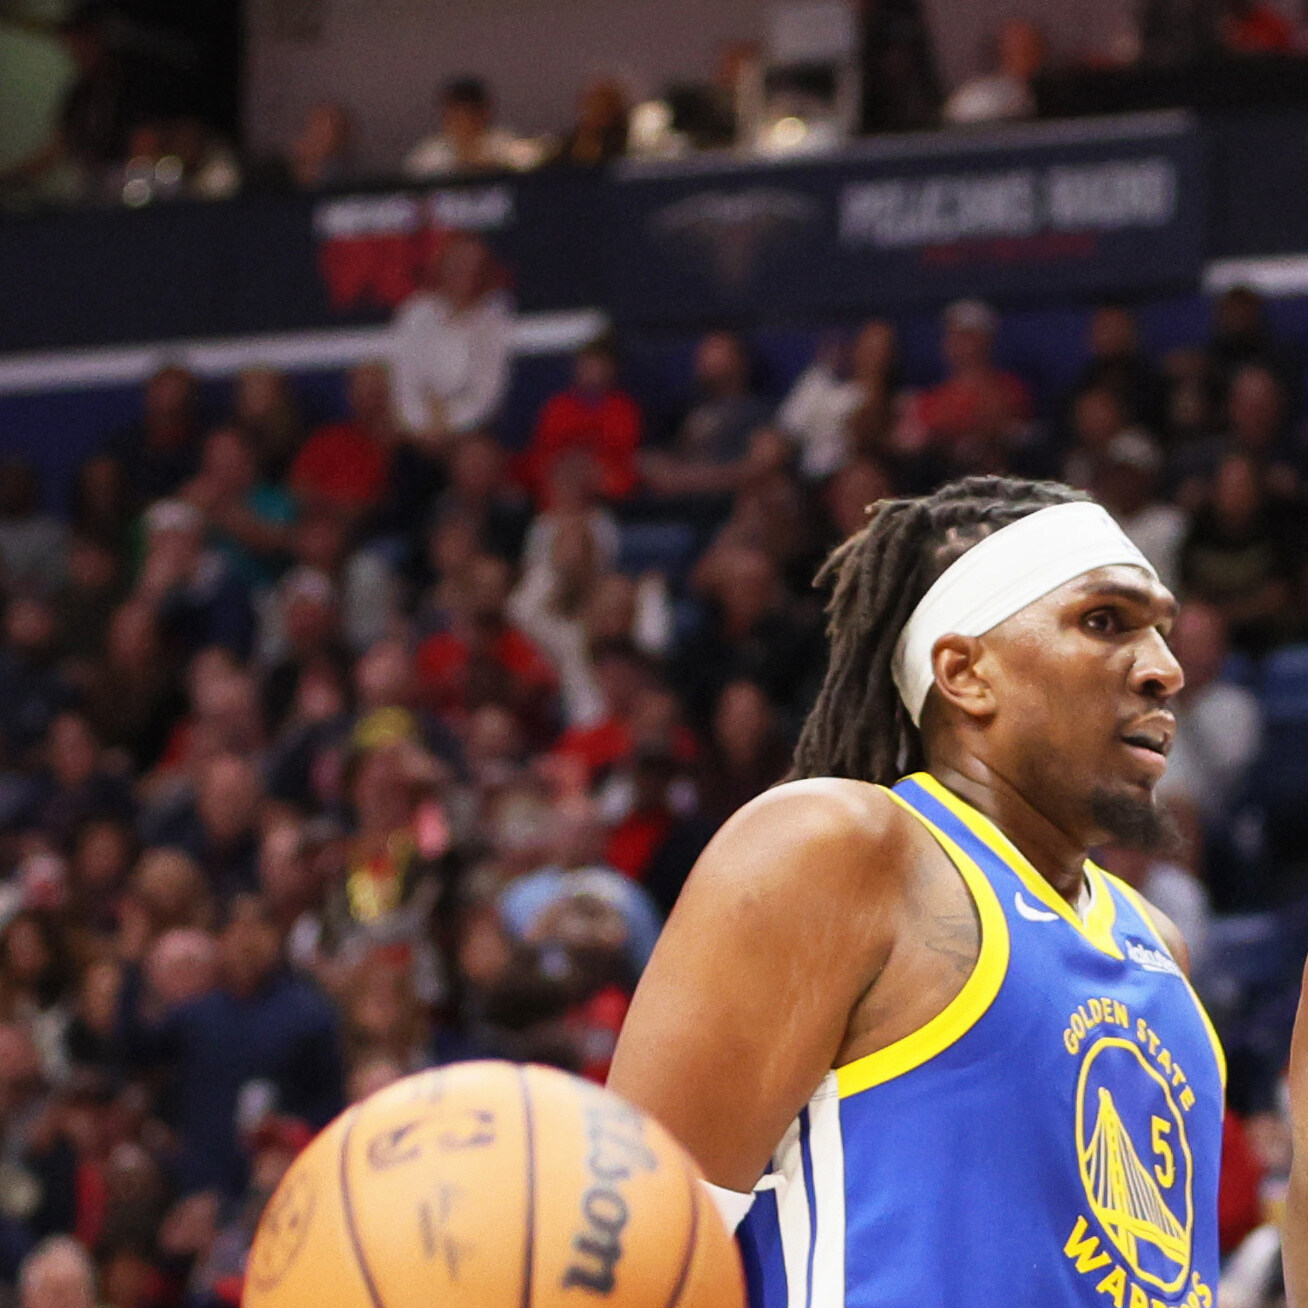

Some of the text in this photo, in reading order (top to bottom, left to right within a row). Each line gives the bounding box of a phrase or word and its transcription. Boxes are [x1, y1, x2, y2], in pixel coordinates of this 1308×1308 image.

[1063, 997, 1196, 1112] GOLDEN STATE
[1151, 1115, 1176, 1188] 5
